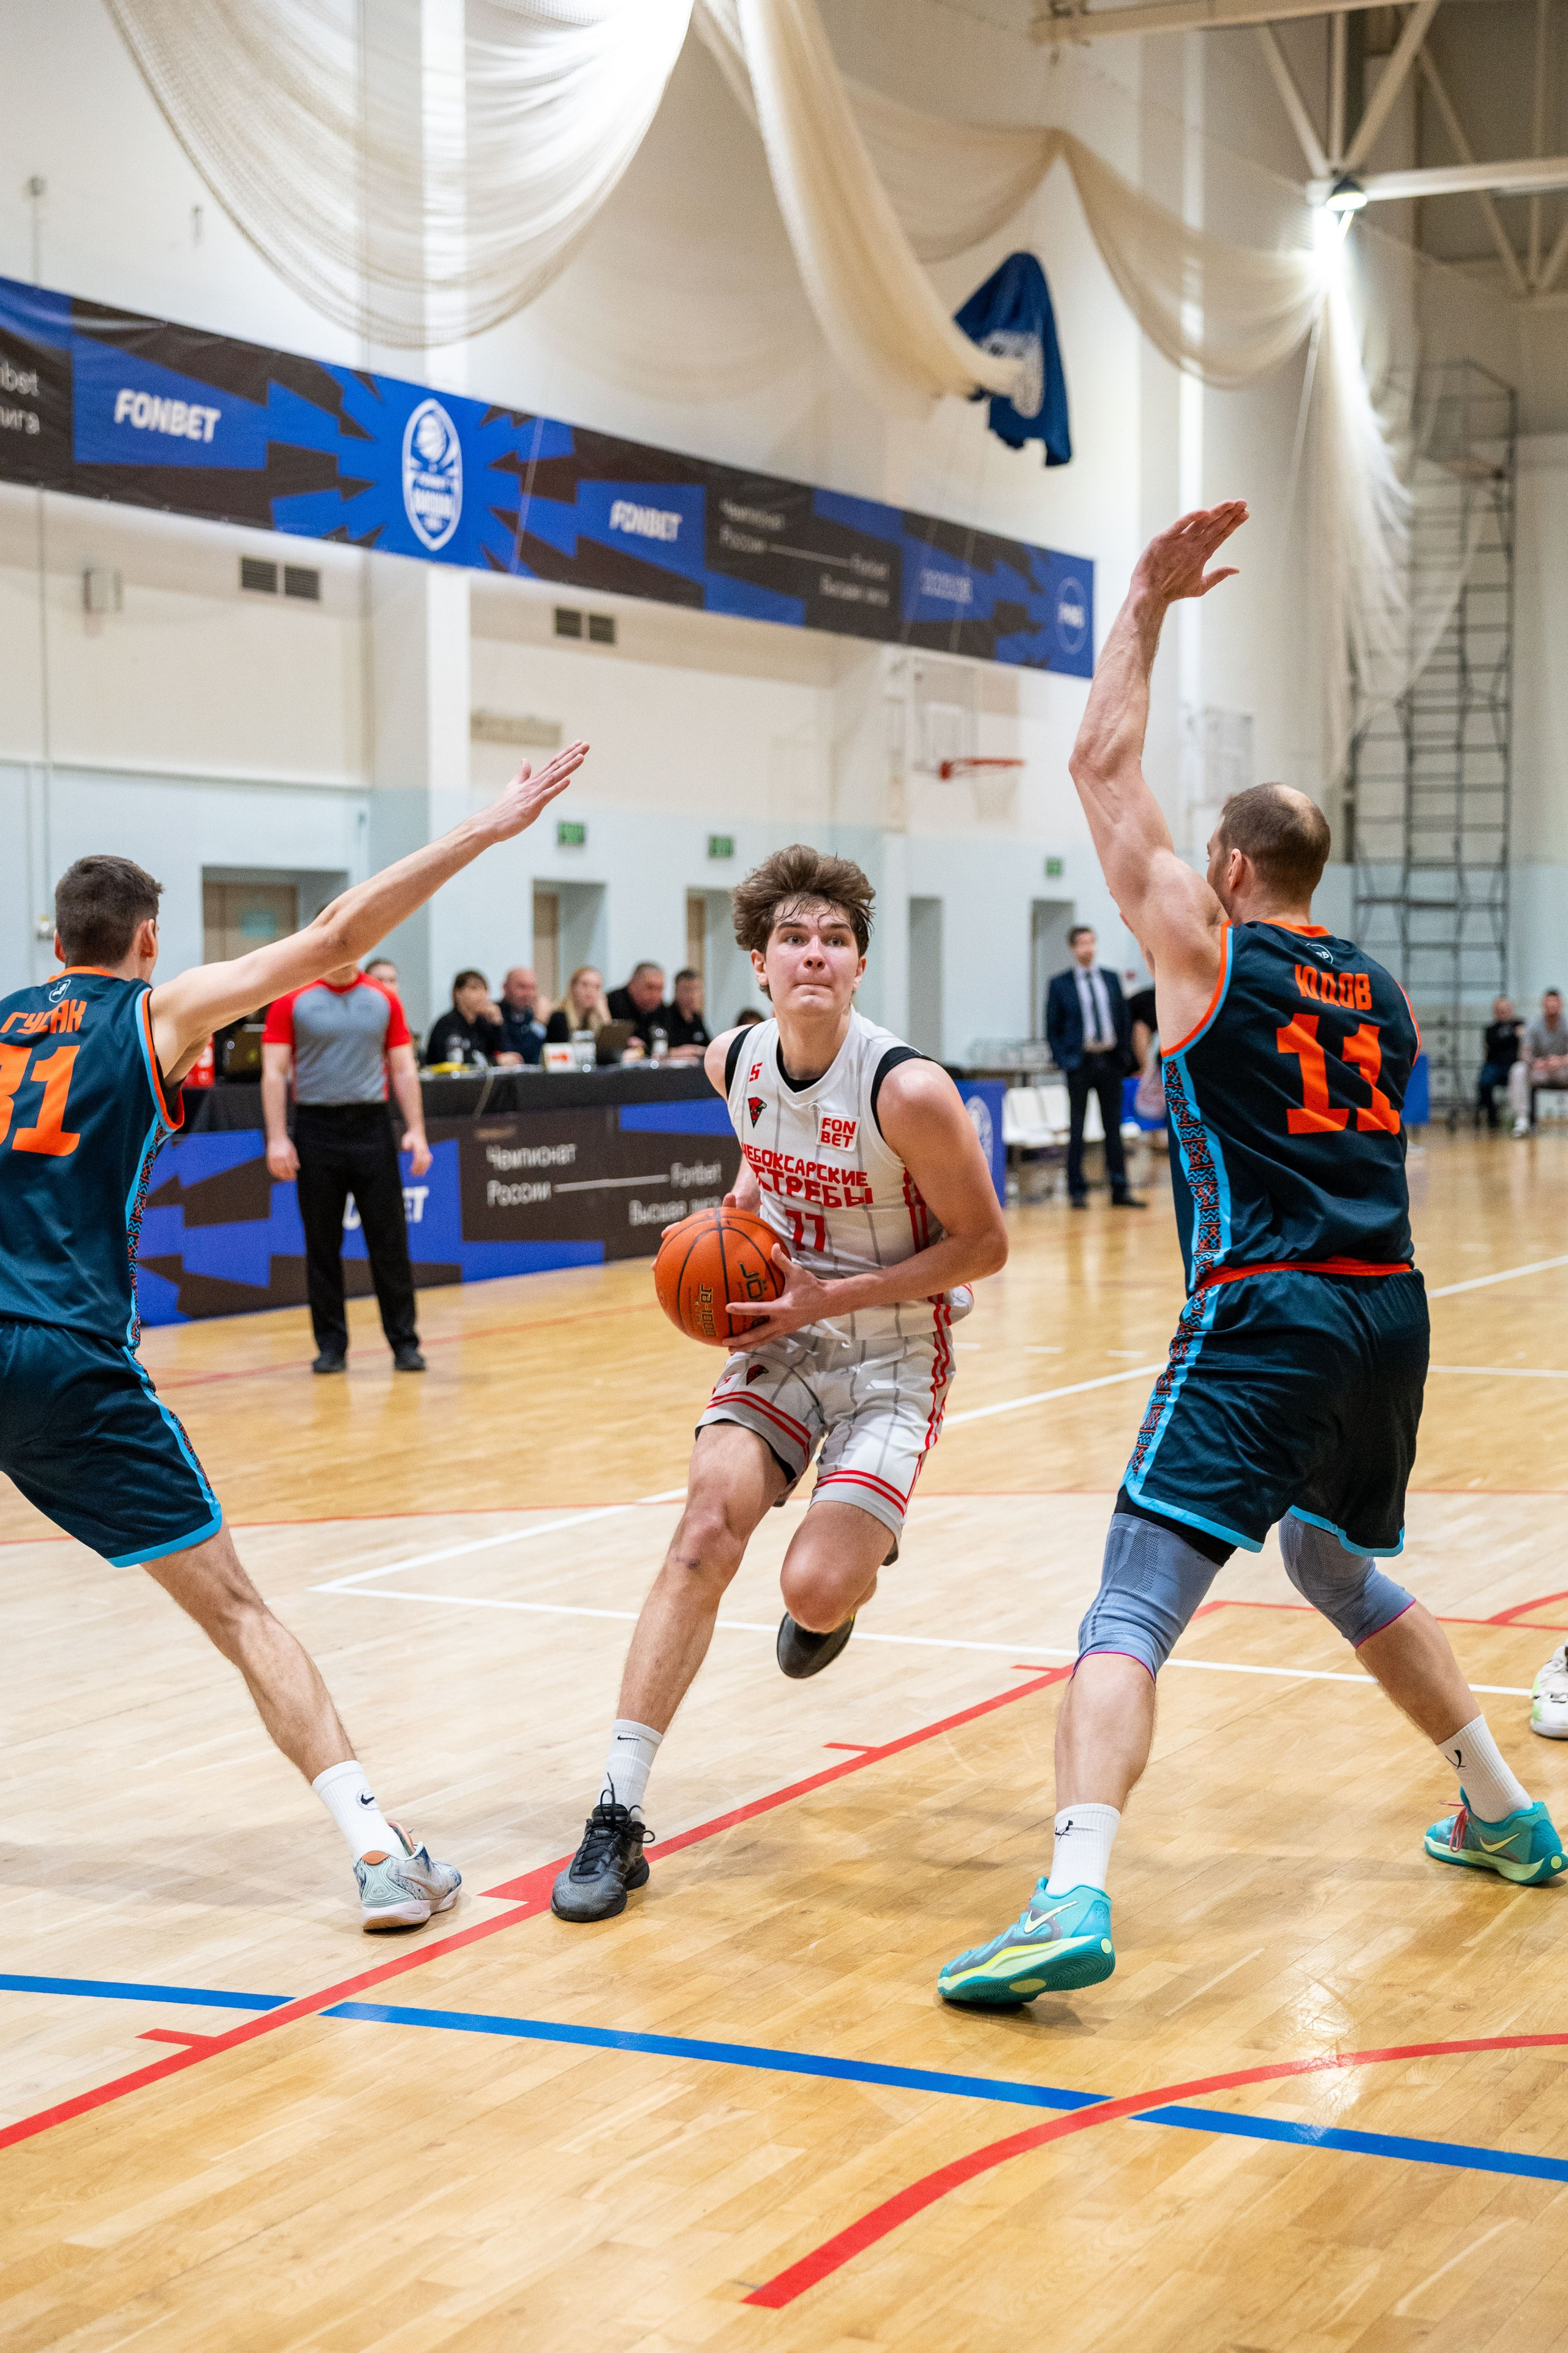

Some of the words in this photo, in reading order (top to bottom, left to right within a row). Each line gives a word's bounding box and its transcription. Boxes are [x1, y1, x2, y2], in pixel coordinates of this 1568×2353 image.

[0, 405, 40, 435] ига
[115, 388, 221, 443] FONBET
[1295, 964, 1372, 1010] ЮДОВ
[0, 999, 87, 1035] ГУСАК
[1276, 1013, 1401, 1135] 11
[820, 1130, 853, 1148] BET
[821, 1117, 856, 1135] FON
[747, 1160, 873, 1208] СТРЕБЫ
